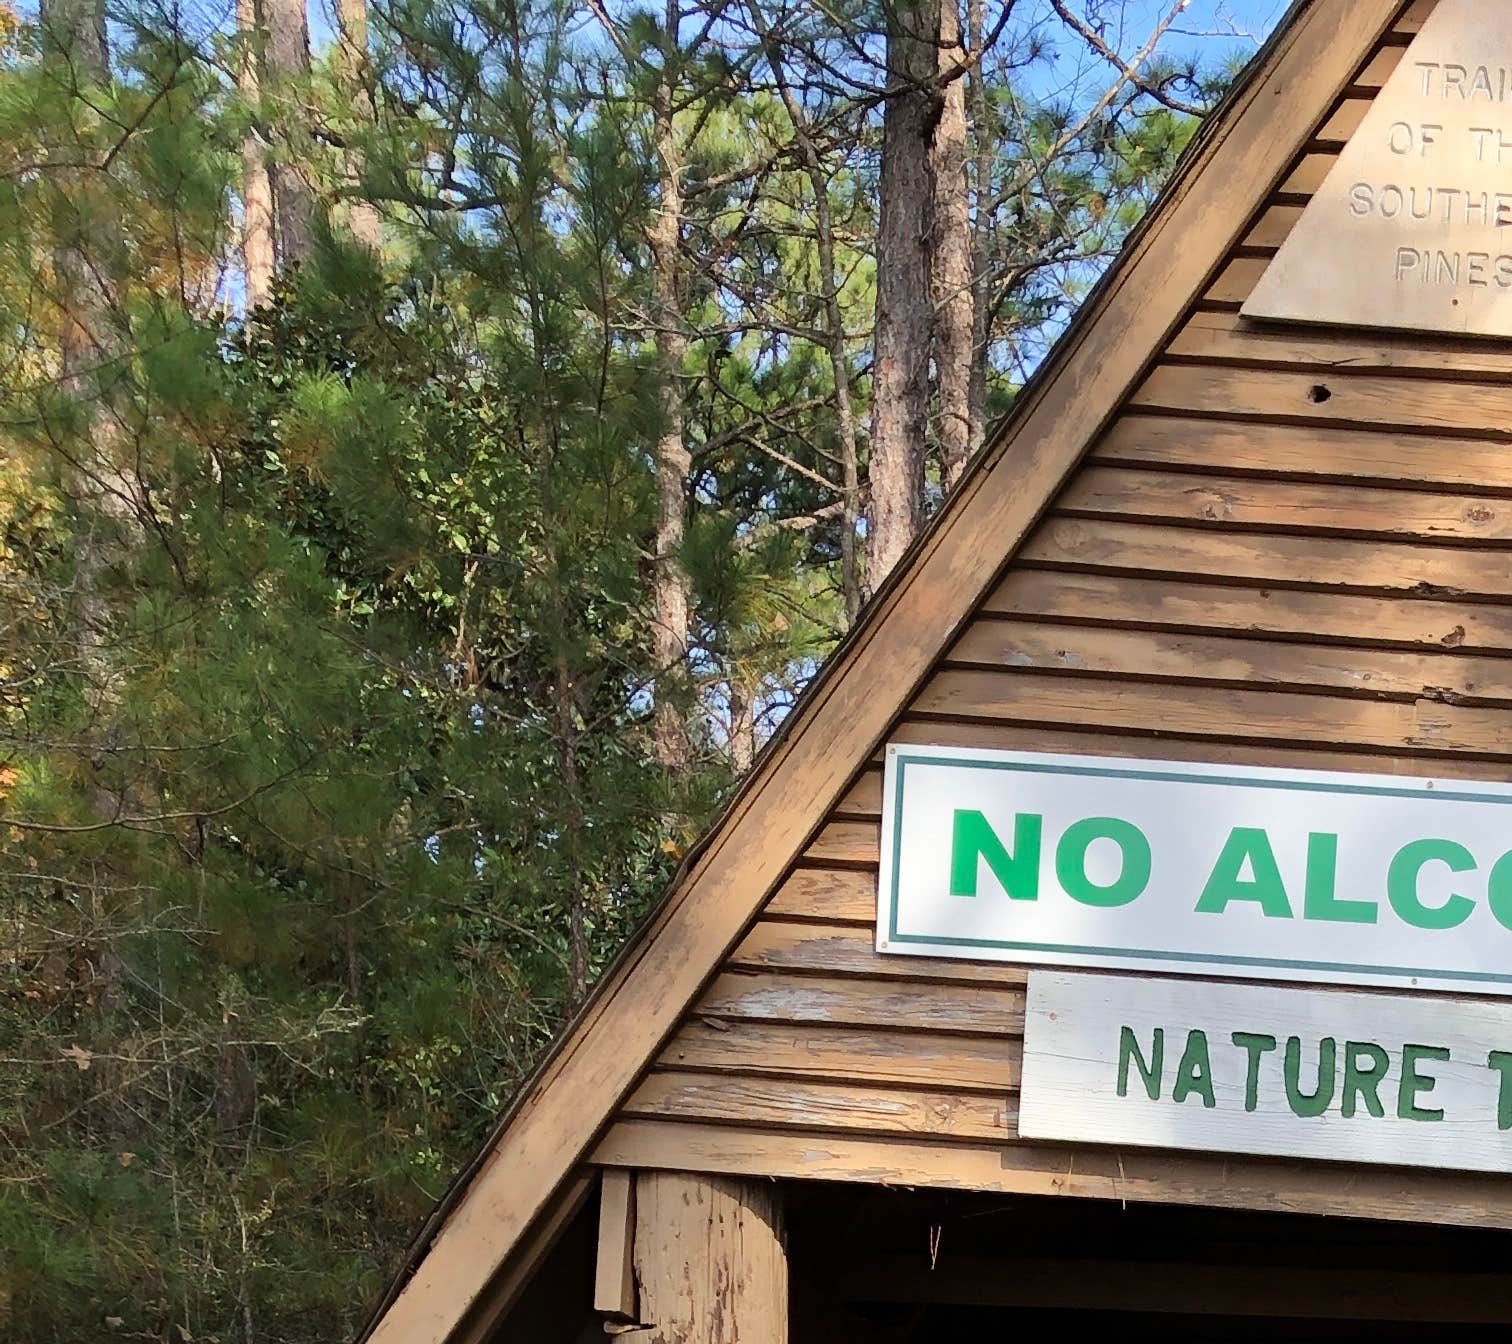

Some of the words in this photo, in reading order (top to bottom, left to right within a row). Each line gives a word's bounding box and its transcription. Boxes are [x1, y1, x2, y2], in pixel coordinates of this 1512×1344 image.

[1387, 121, 1443, 157] OF
[949, 808, 1153, 909] NO
[1115, 1024, 1451, 1122] NATURE
